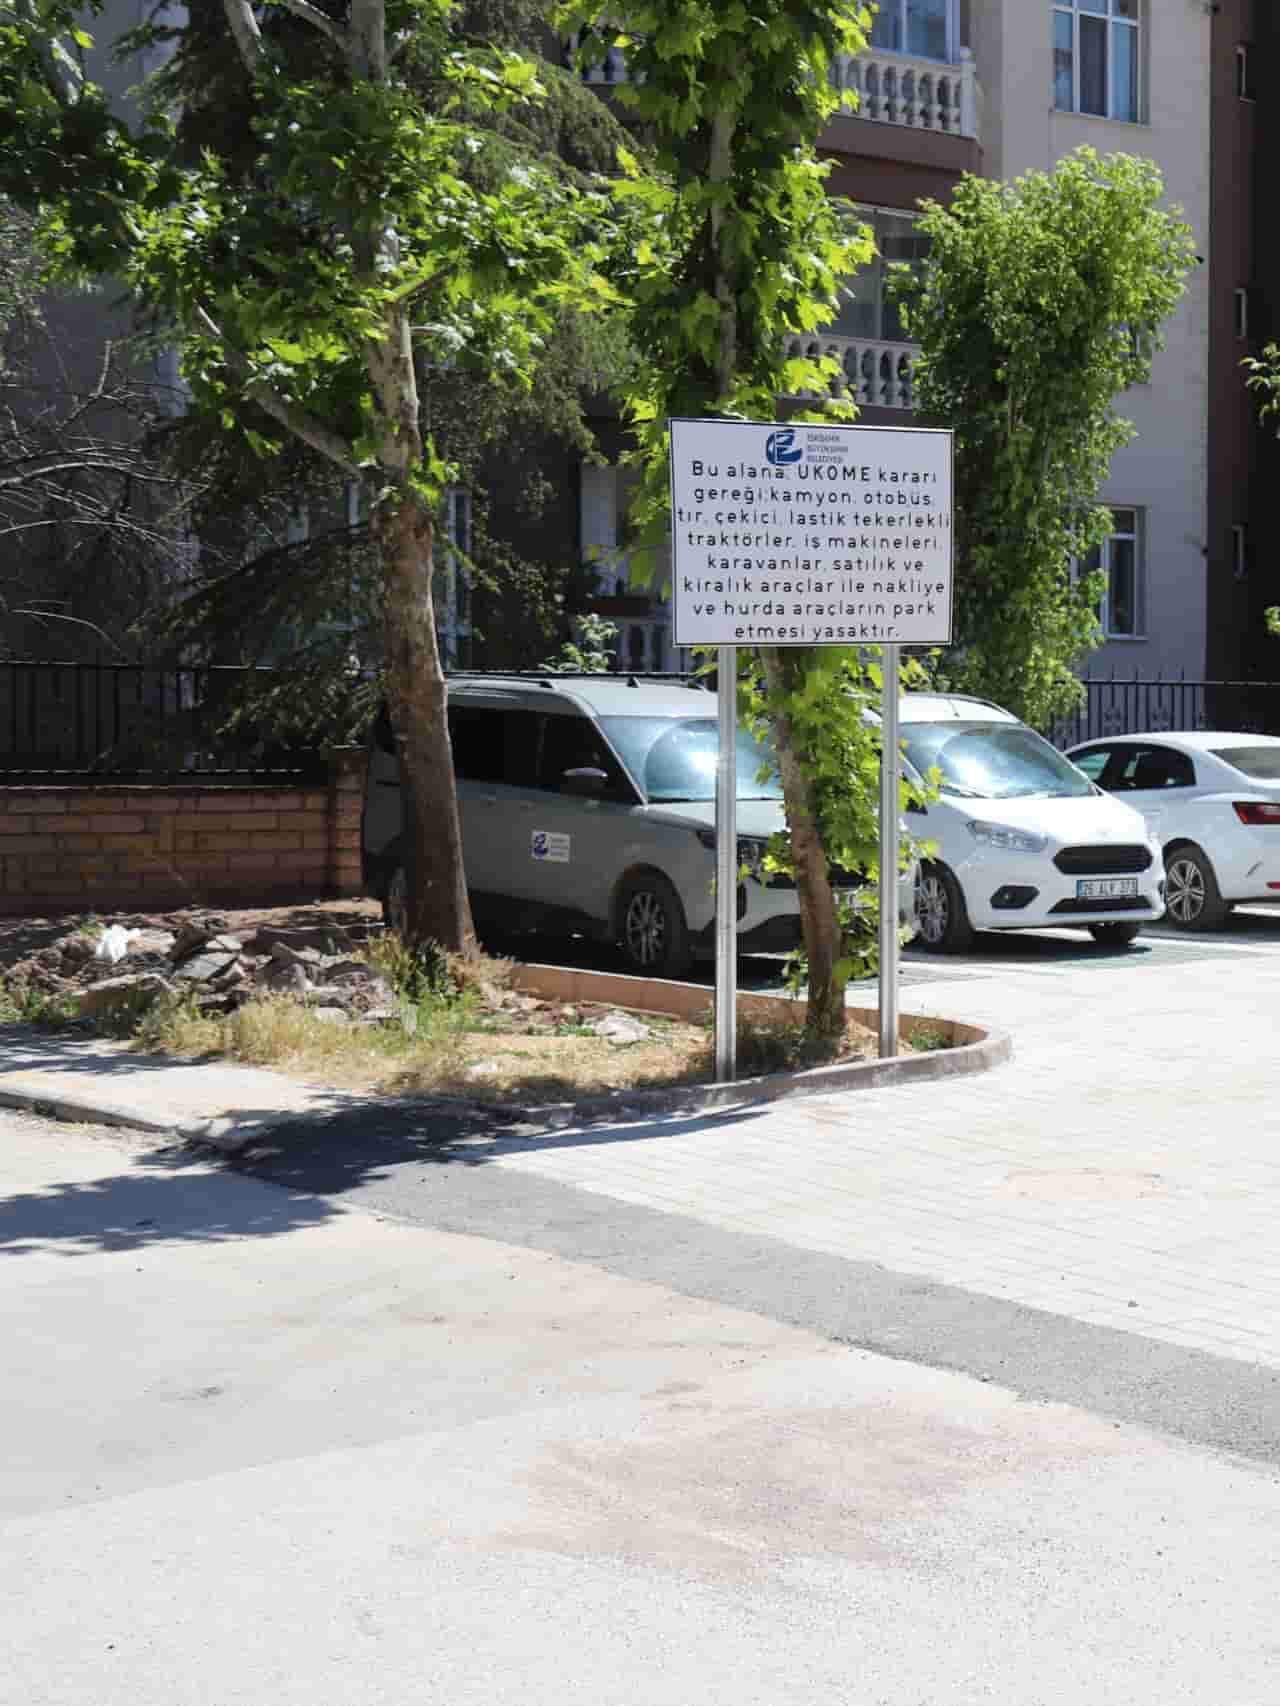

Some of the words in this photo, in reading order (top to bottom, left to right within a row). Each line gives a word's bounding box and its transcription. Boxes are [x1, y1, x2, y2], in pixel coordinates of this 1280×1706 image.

[692, 461, 718, 477] Bu
[798, 466, 871, 480] UKOME
[878, 469, 936, 484] kararı
[790, 512, 846, 525] lastik
[854, 512, 950, 528] tekerlekli
[804, 536, 820, 549] iş
[834, 556, 896, 570] satılık
[904, 559, 924, 570] ve
[684, 577, 753, 592] kiralık
[760, 578, 834, 594] araçlar
[842, 578, 864, 592] ile
[873, 578, 944, 596] nakliye
[692, 603, 715, 615] ve
[724, 600, 785, 616] hurda
[792, 601, 884, 618] araçların
[894, 602, 936, 619] park
[736, 624, 803, 638] etmesi
[813, 624, 900, 640] yasaktır.
